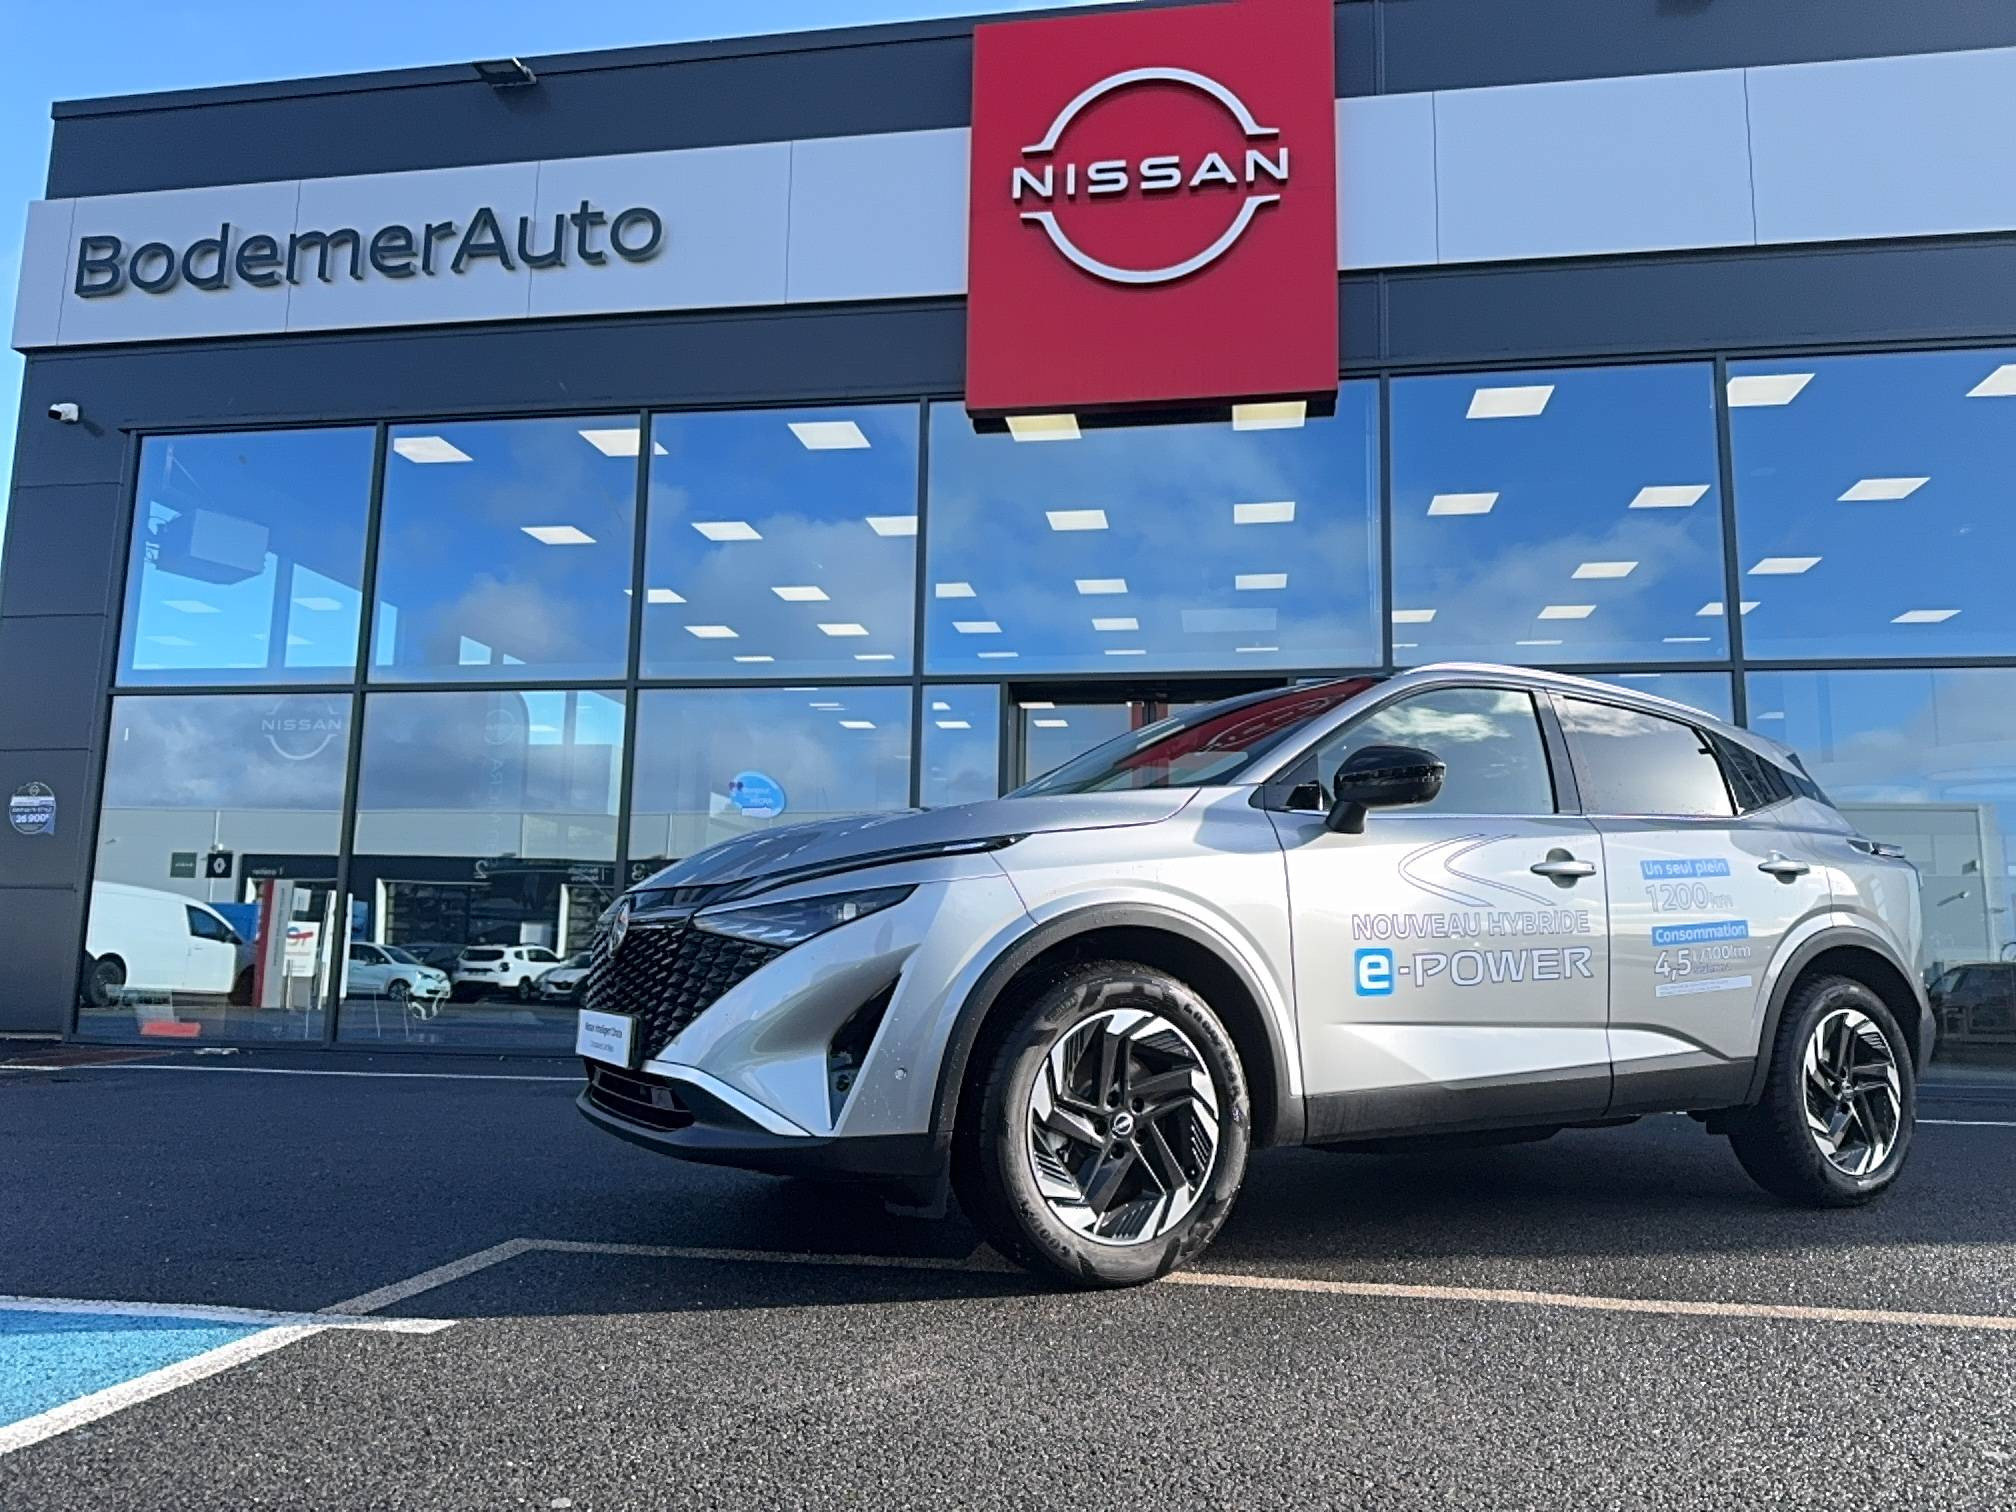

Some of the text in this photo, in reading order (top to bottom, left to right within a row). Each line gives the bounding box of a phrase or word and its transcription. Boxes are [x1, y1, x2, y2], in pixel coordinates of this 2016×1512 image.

[1011, 147, 1289, 200] NISSAN
[74, 199, 663, 298] BodemerAuto
[261, 719, 342, 731] NISSAN
[1643, 859, 1727, 877] Un seul plein
[1352, 910, 1591, 941] NOUVEAU HYBRIDE
[1655, 923, 1747, 943] Consommation
[1356, 945, 1595, 991] e-POWER
[1654, 948, 1692, 982] 4,5
